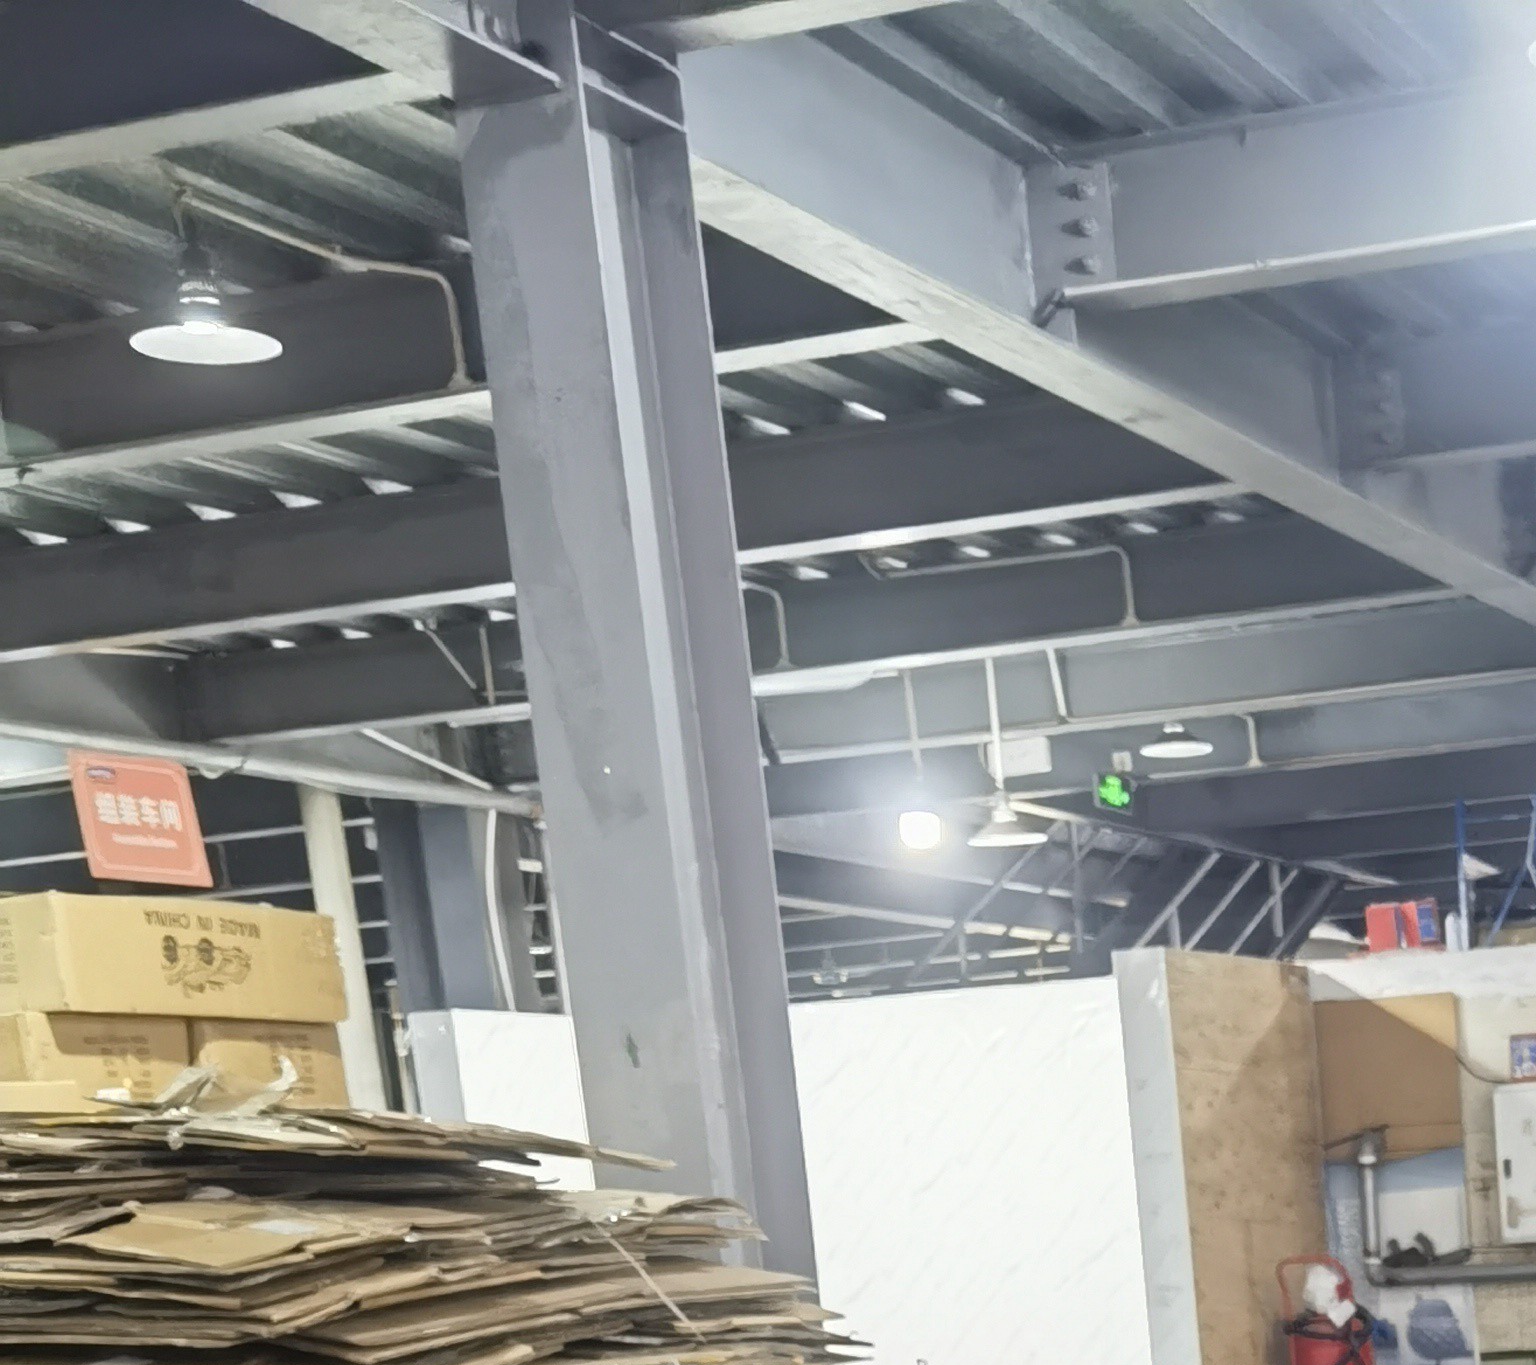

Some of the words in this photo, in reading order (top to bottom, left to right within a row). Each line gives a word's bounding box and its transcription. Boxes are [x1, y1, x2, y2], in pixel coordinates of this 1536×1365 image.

[143, 909, 191, 930] CHINA
[196, 914, 214, 932] IN
[219, 916, 261, 939] MADE
